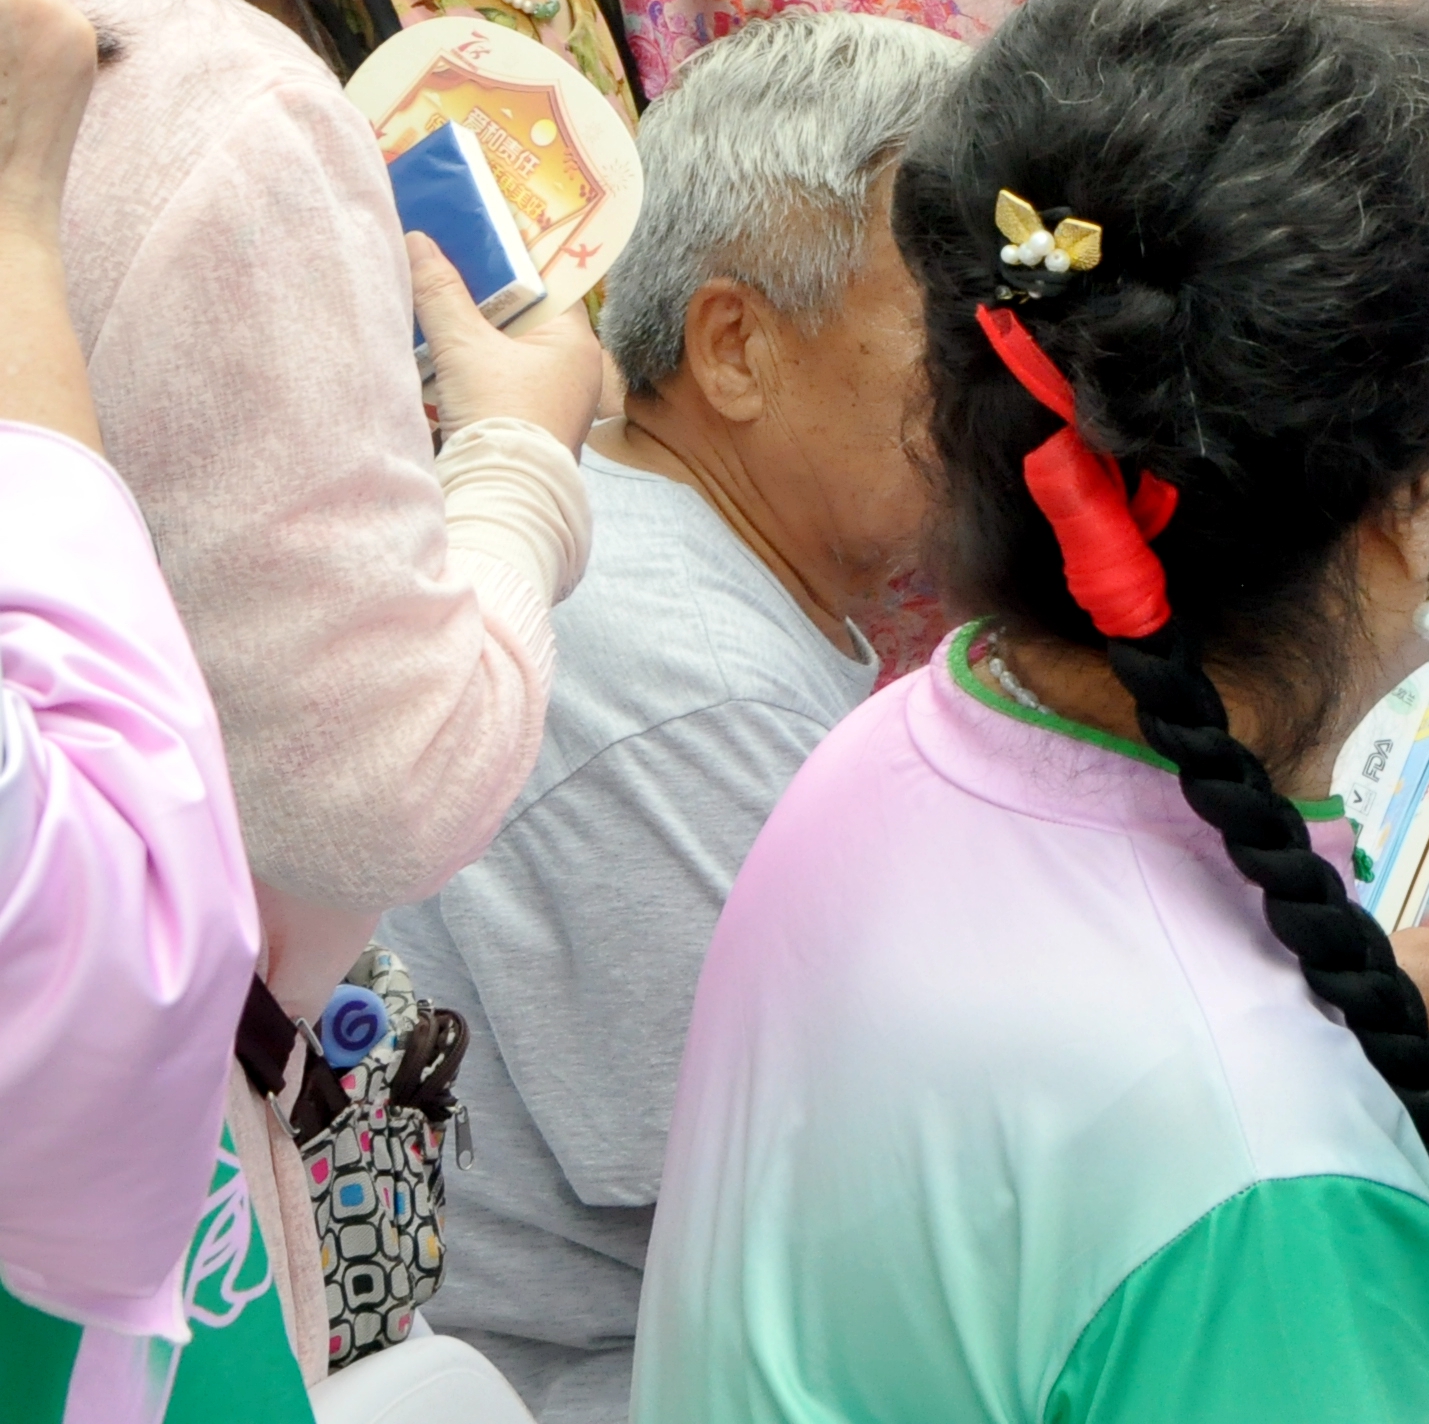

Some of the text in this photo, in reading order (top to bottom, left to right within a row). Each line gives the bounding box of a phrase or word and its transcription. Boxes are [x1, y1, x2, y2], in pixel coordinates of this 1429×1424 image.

[462, 105, 540, 179] 爱和责任
[1362, 738, 1394, 783] FDA
